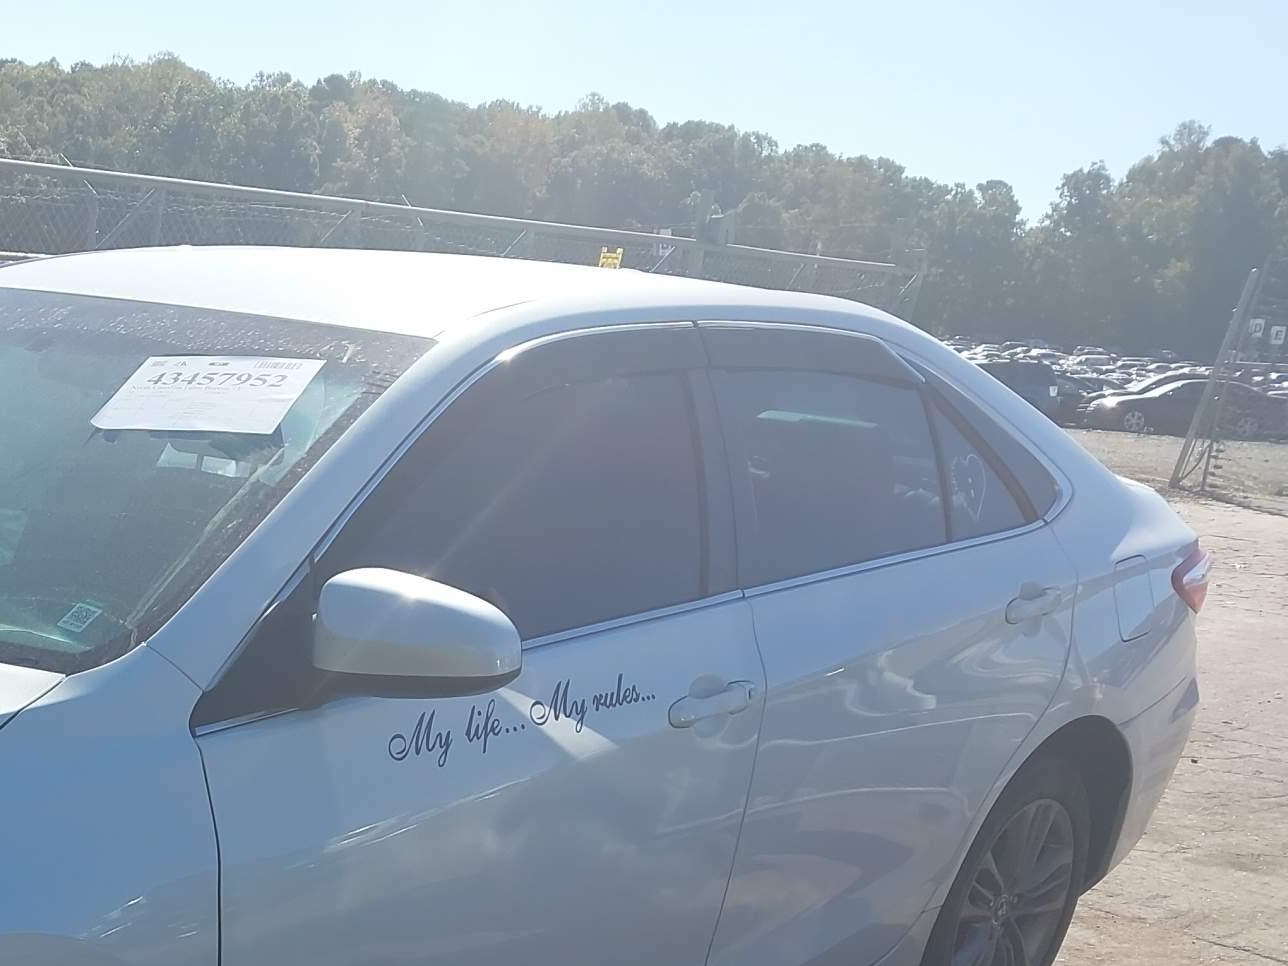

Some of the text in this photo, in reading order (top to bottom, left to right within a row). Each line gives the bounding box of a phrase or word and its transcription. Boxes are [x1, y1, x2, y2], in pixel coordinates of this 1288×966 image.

[146, 372, 289, 388] 43457952
[388, 673, 656, 767] My life... My rules...
